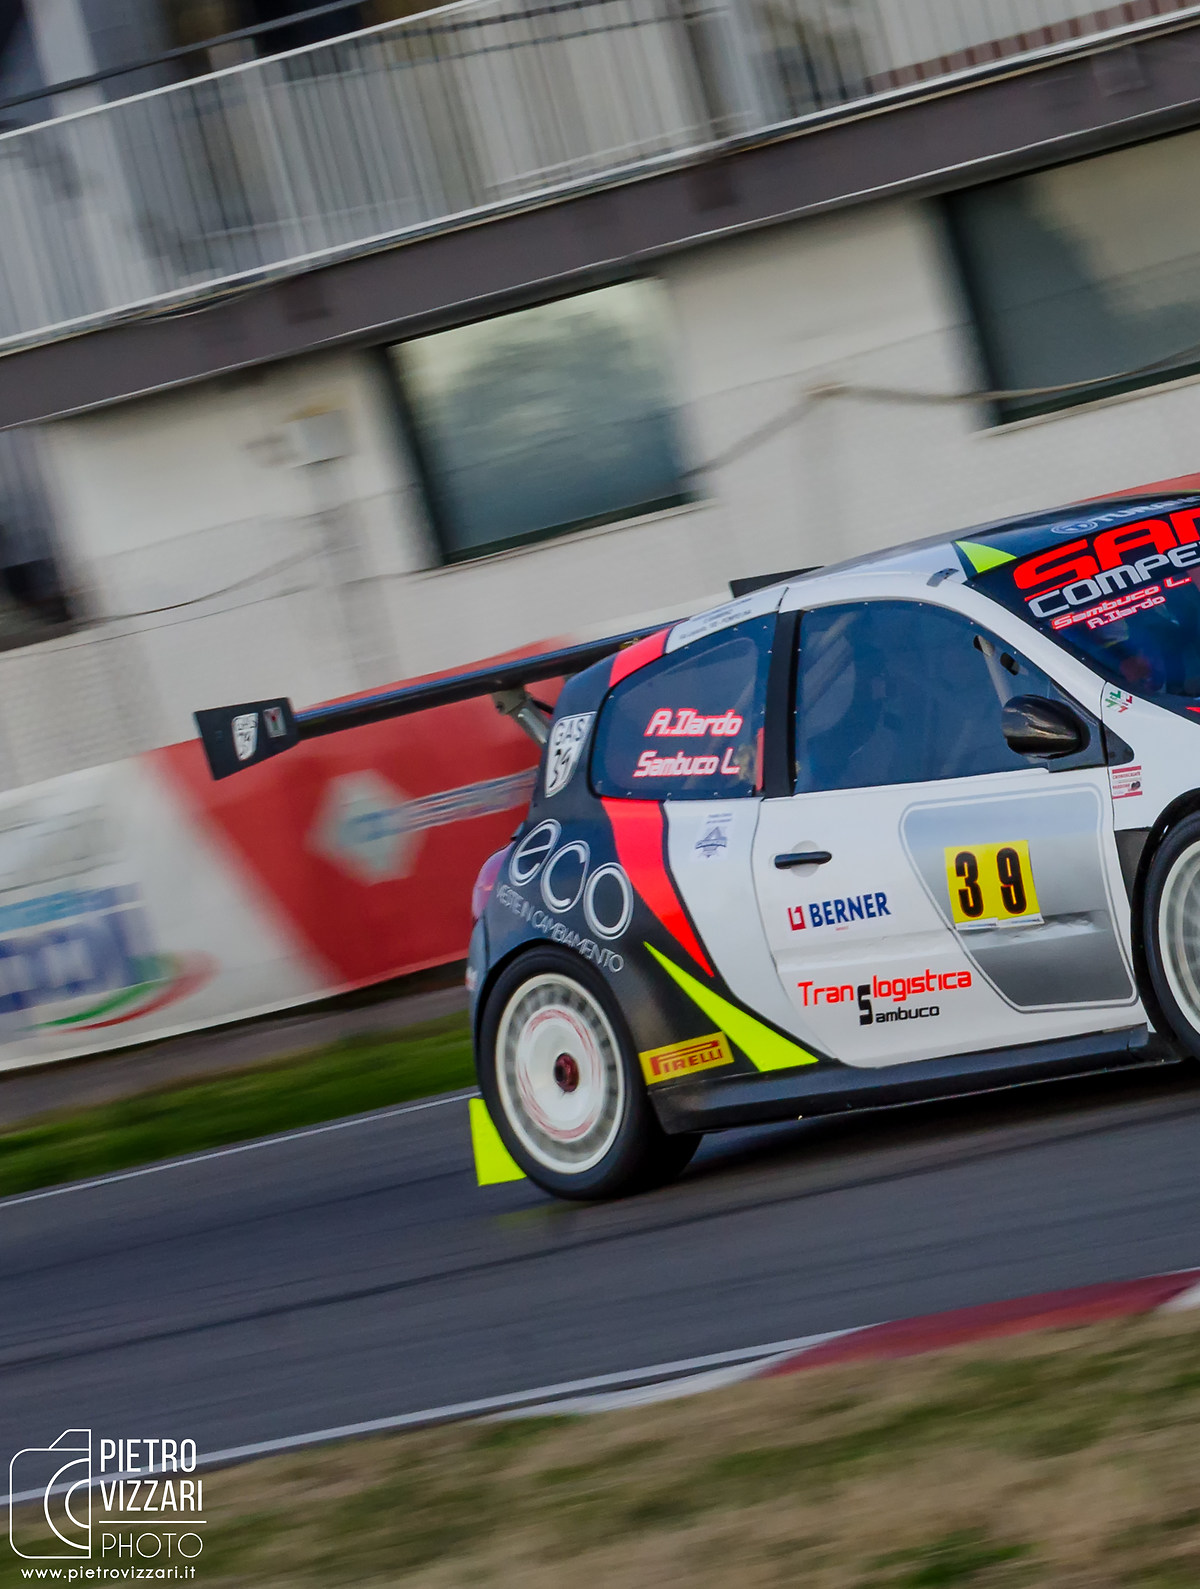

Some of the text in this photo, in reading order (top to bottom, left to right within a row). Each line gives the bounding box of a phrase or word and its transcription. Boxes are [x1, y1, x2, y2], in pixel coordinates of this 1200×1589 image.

[1051, 577, 1192, 629] Sambuco L.
[632, 749, 719, 777] Sambuco
[508, 818, 634, 940] eco
[955, 847, 1027, 918] 39
[808, 892, 891, 927] BERNER
[650, 1040, 722, 1076] PIRELLI
